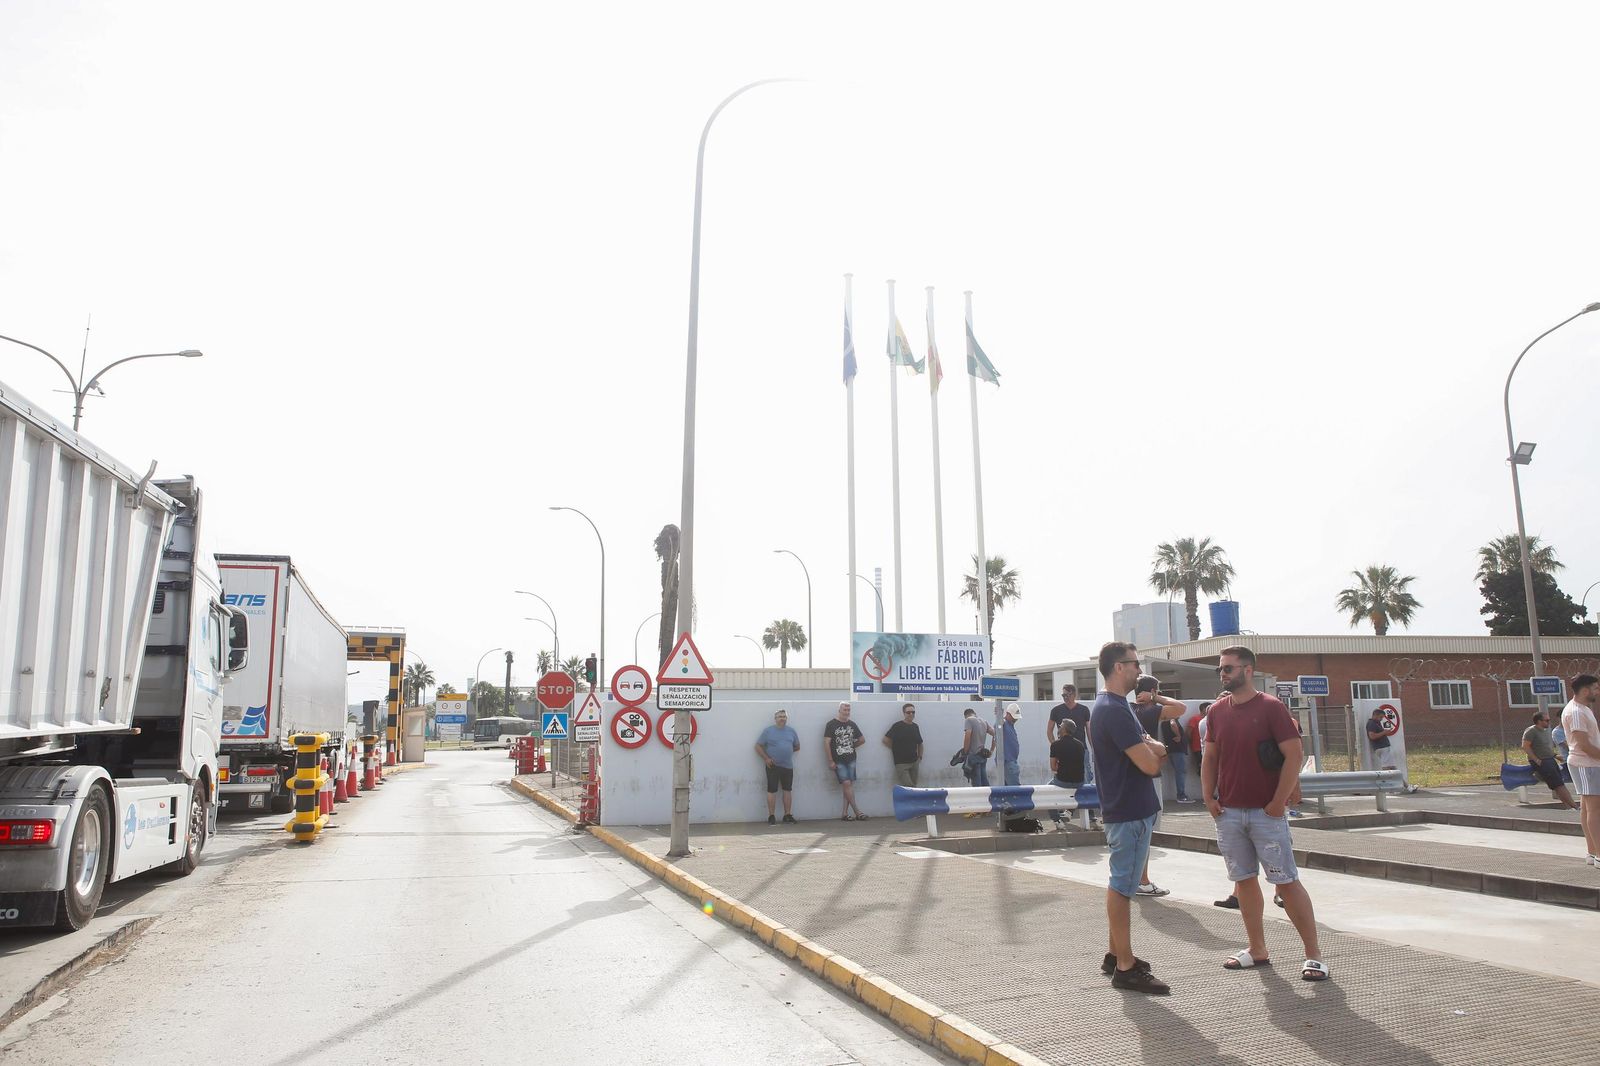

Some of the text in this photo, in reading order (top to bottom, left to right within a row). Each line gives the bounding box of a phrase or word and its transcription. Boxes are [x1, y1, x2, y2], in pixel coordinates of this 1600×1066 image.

[937, 639, 957, 647] Estás
[937, 647, 985, 663] FÁBRICA
[899, 665, 985, 681] LIBRE DE HUMO
[539, 685, 573, 695] STOP
[662, 692, 707, 700] SEÑALIZACIÓN
